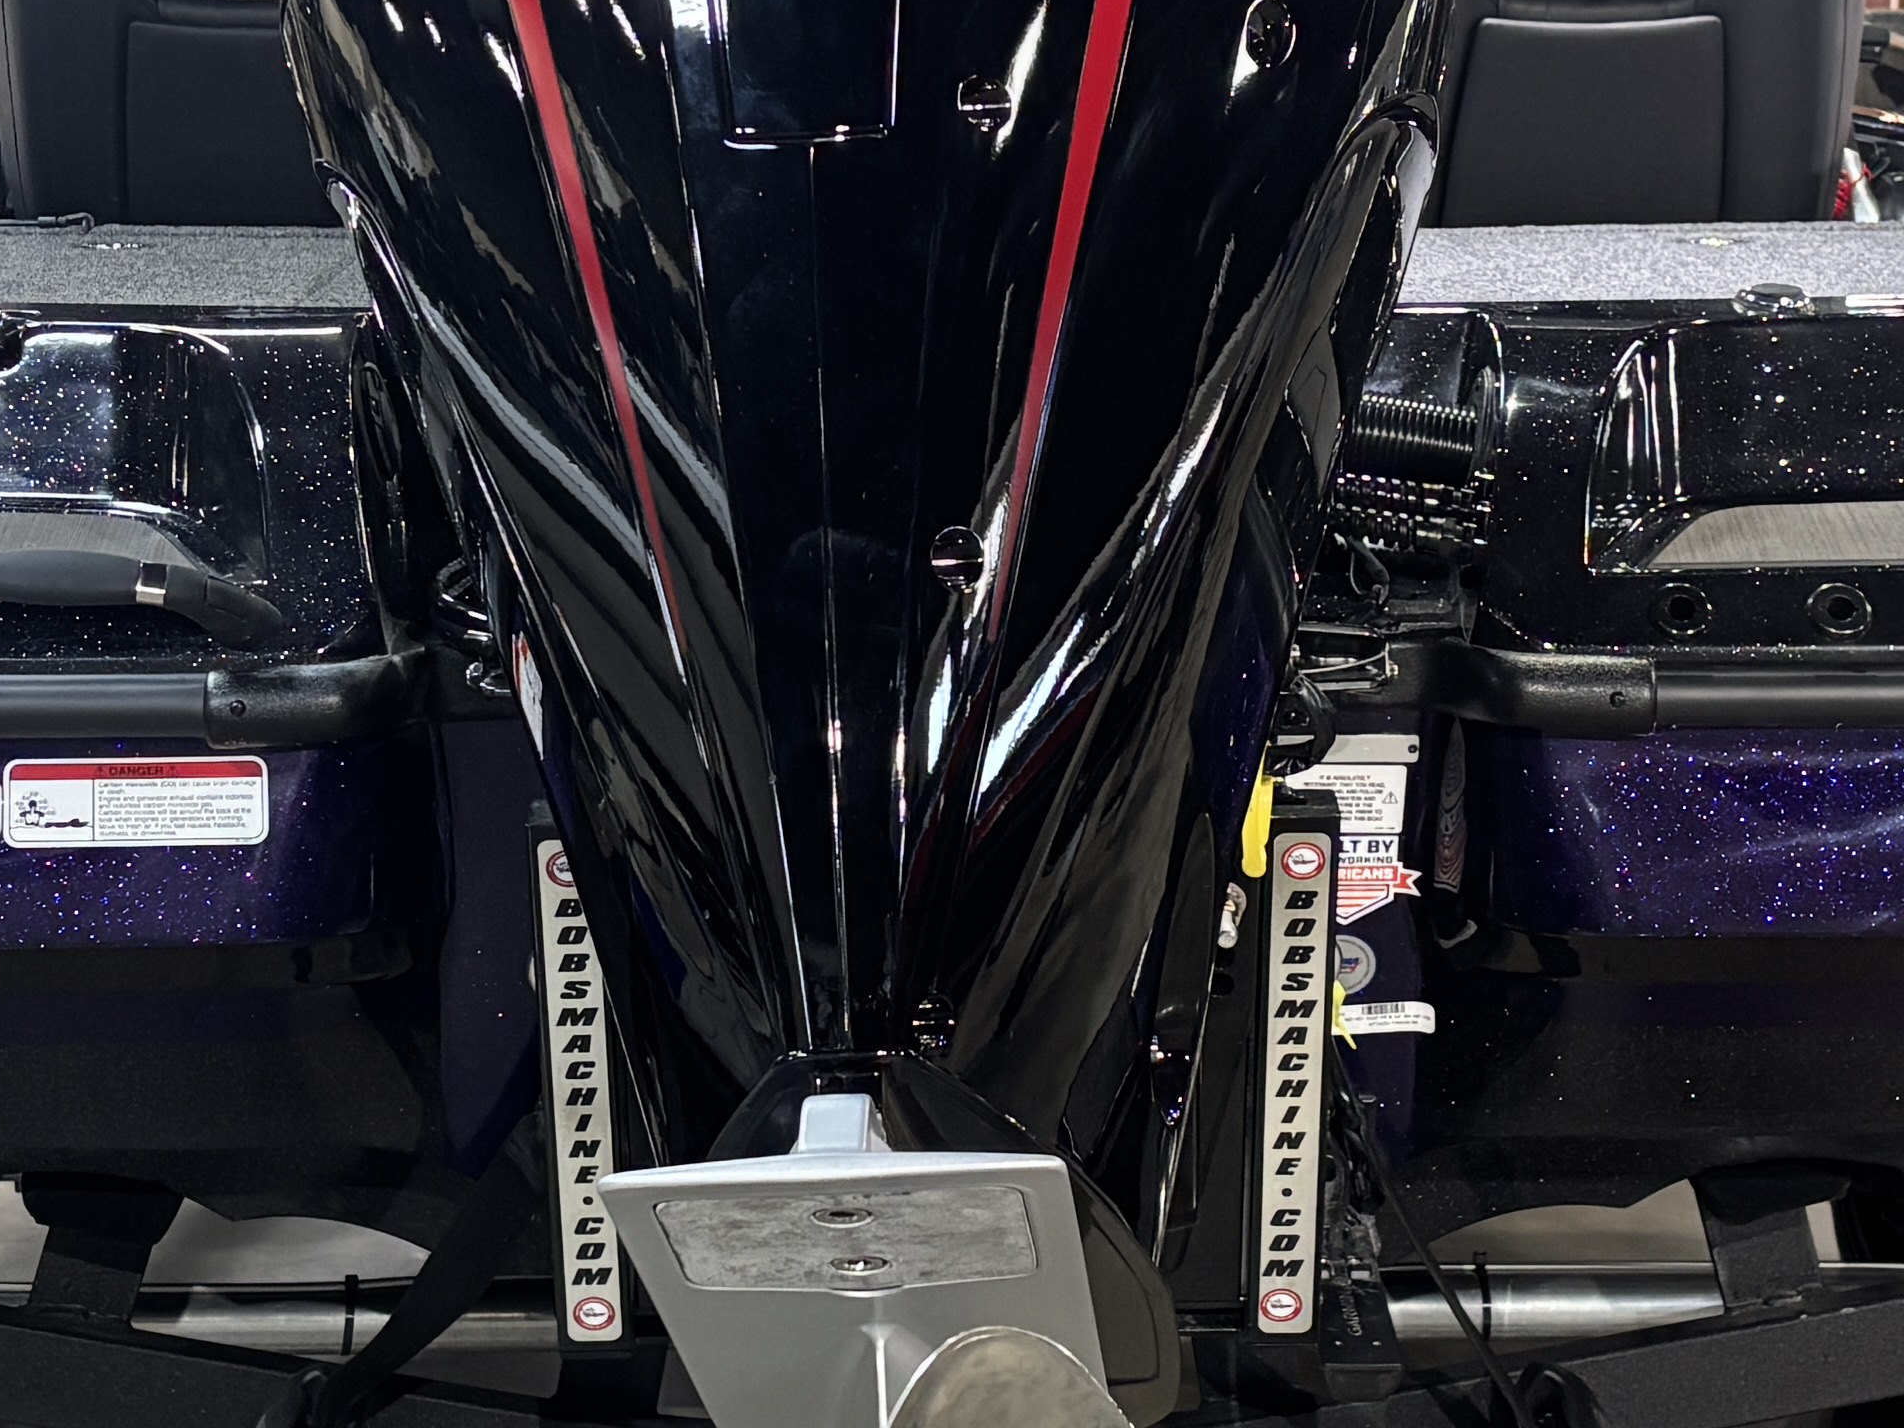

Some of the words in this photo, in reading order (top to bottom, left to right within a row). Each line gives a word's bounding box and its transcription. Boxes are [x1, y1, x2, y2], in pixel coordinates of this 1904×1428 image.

[108, 766, 164, 777] DANGER
[1339, 840, 1362, 853] LT
[1367, 840, 1394, 853] BY
[1338, 868, 1395, 881] RICANS
